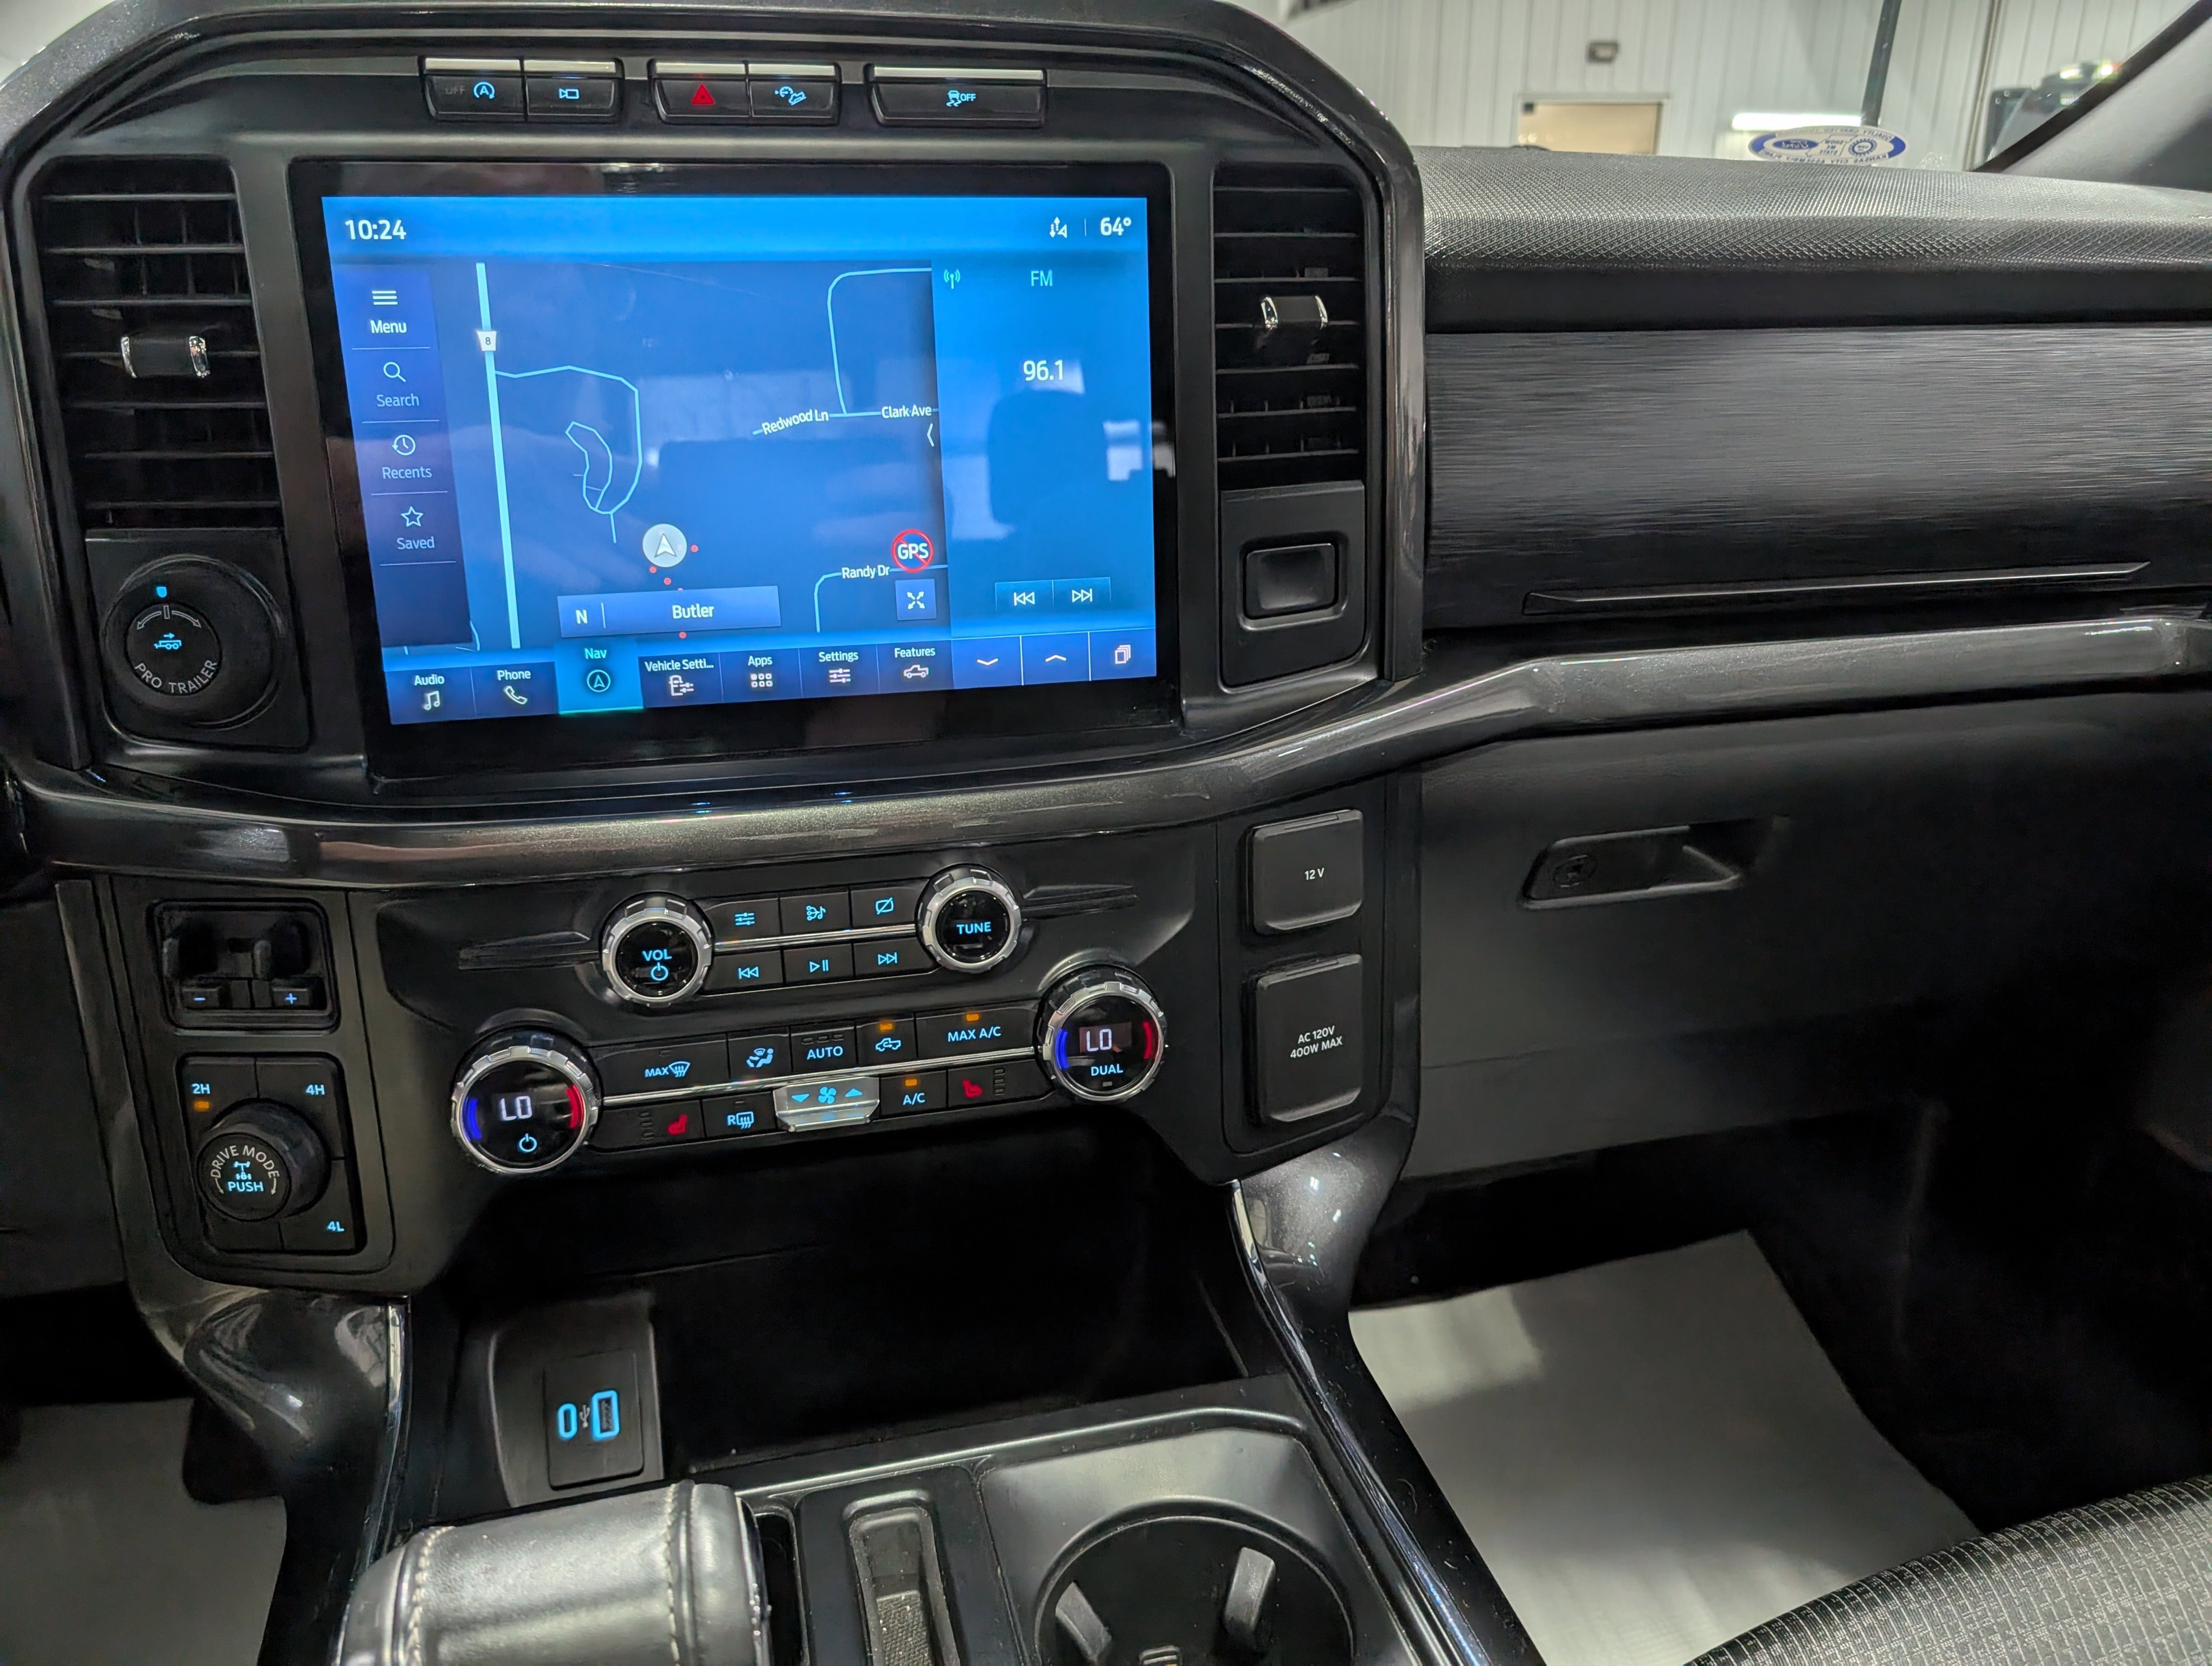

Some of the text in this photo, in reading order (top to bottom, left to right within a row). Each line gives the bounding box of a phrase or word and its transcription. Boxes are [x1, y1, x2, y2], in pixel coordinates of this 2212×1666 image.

[960, 93, 976, 102] OFF
[345, 219, 407, 240] 10:24
[1100, 217, 1132, 236] 64°
[1031, 270, 1053, 287] FM
[370, 319, 407, 334] Menu
[485, 336, 491, 346] 8
[1023, 360, 1064, 382] 96.1
[376, 393, 420, 408] Search
[881, 404, 933, 419] Clark Ave
[762, 409, 829, 435] Redwood Ln
[382, 465, 432, 479] Recents
[396, 536, 435, 550] Saved
[897, 543, 929, 560] GPS
[842, 565, 890, 579] Randy Dr
[575, 609, 588, 624] N
[672, 604, 715, 619] Butler
[584, 648, 607, 660] Nav
[818, 650, 859, 663] Settings
[894, 647, 936, 658] Features
[645, 658, 715, 672] Vehicle Setti...
[748, 655, 773, 668] Apps
[134, 659, 217, 694] PRO TRAILER
[414, 674, 445, 686] Audio
[496, 669, 531, 681] Phone
[1304, 867, 1325, 881] 12 V
[956, 920, 992, 935] TUNE
[641, 948, 672, 962] VOL
[947, 1025, 1001, 1043] MAX A/C
[1086, 1029, 1112, 1053] LO
[1297, 1025, 1335, 1045] AC 120V
[806, 1045, 844, 1060] AUTO
[1289, 1035, 1343, 1059] 400W MAX
[645, 1066, 669, 1078] MAX
[1090, 1063, 1124, 1077] DUAL
[191, 1083, 211, 1095] 2H
[305, 1084, 325, 1095] 4H
[902, 1092, 925, 1106] A/C
[501, 1095, 532, 1122] LO
[726, 1114, 736, 1126] R
[210, 1145, 280, 1179] DRIVE MODE
[228, 1181, 264, 1193] PUSH
[327, 1221, 345, 1233] 4L
